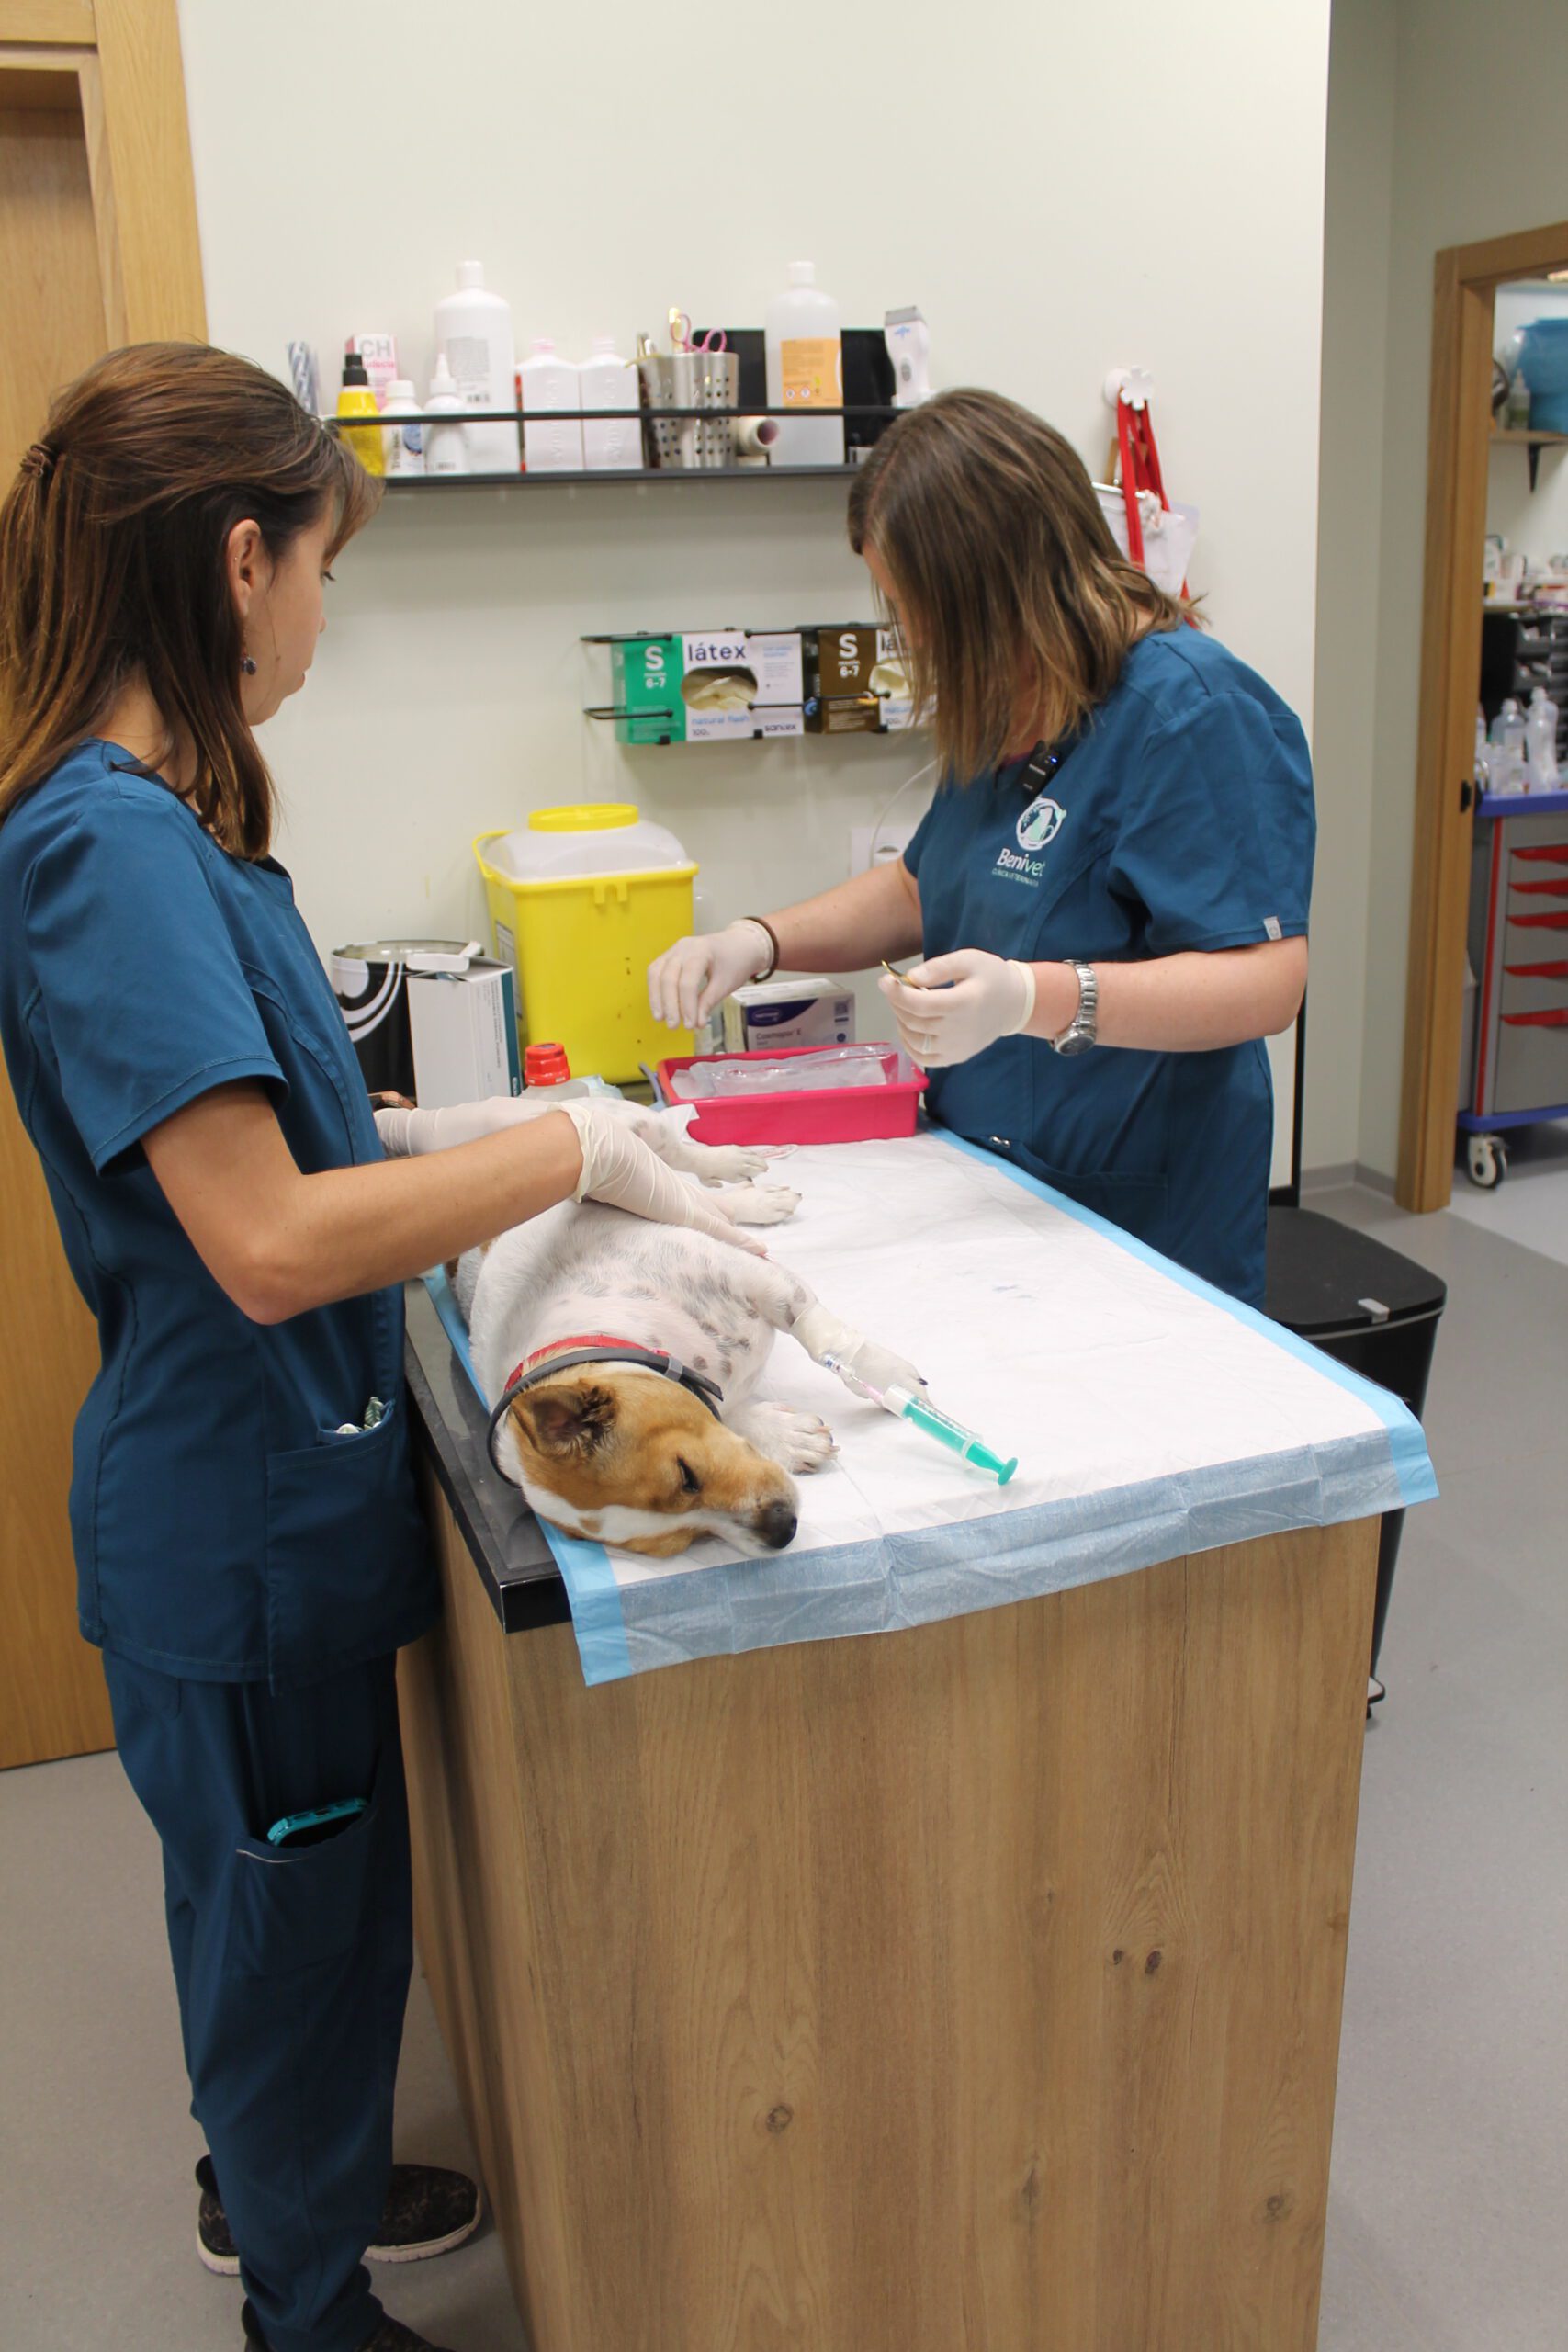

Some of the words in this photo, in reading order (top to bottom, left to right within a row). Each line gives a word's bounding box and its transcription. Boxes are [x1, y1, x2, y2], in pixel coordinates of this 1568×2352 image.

[688, 641, 746, 662] látex
[839, 632, 859, 660] S
[644, 644, 665, 670] S
[840, 665, 861, 679] 6-7
[646, 677, 666, 689] 6-7
[691, 716, 725, 725] natural
[996, 847, 1046, 877] Benivet
